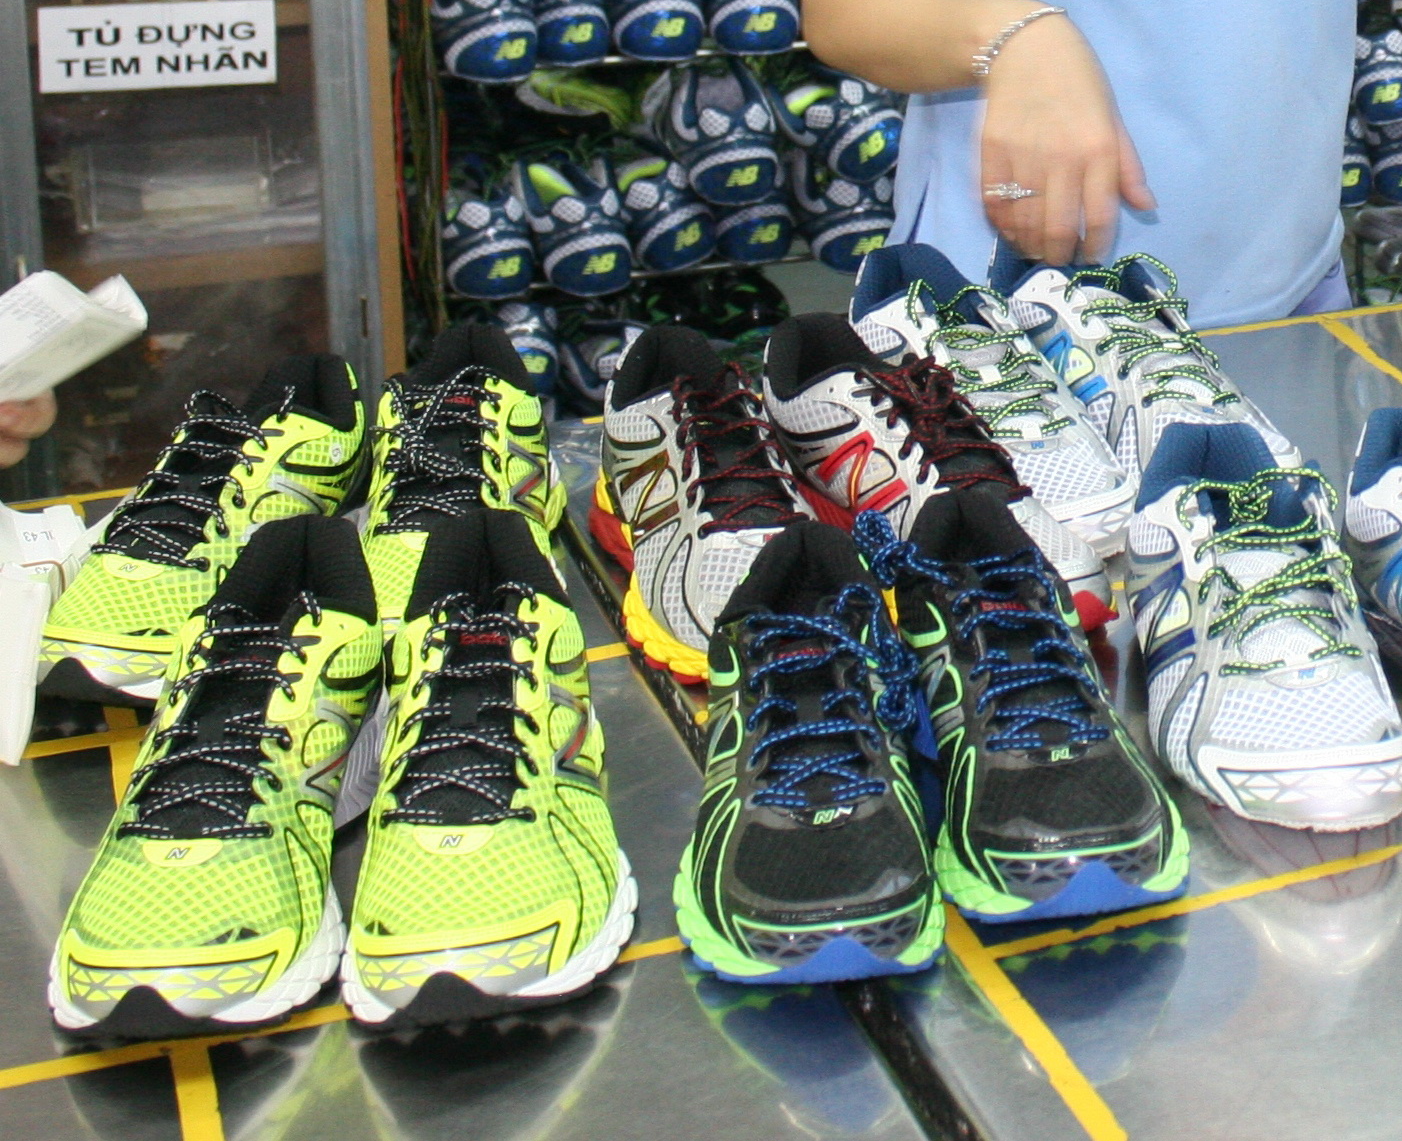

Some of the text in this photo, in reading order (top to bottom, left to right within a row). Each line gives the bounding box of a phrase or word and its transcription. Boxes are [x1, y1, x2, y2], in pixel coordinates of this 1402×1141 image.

[68, 20, 257, 48] TỦ ĐỰNG
[57, 46, 268, 77] TEM NHÃN
